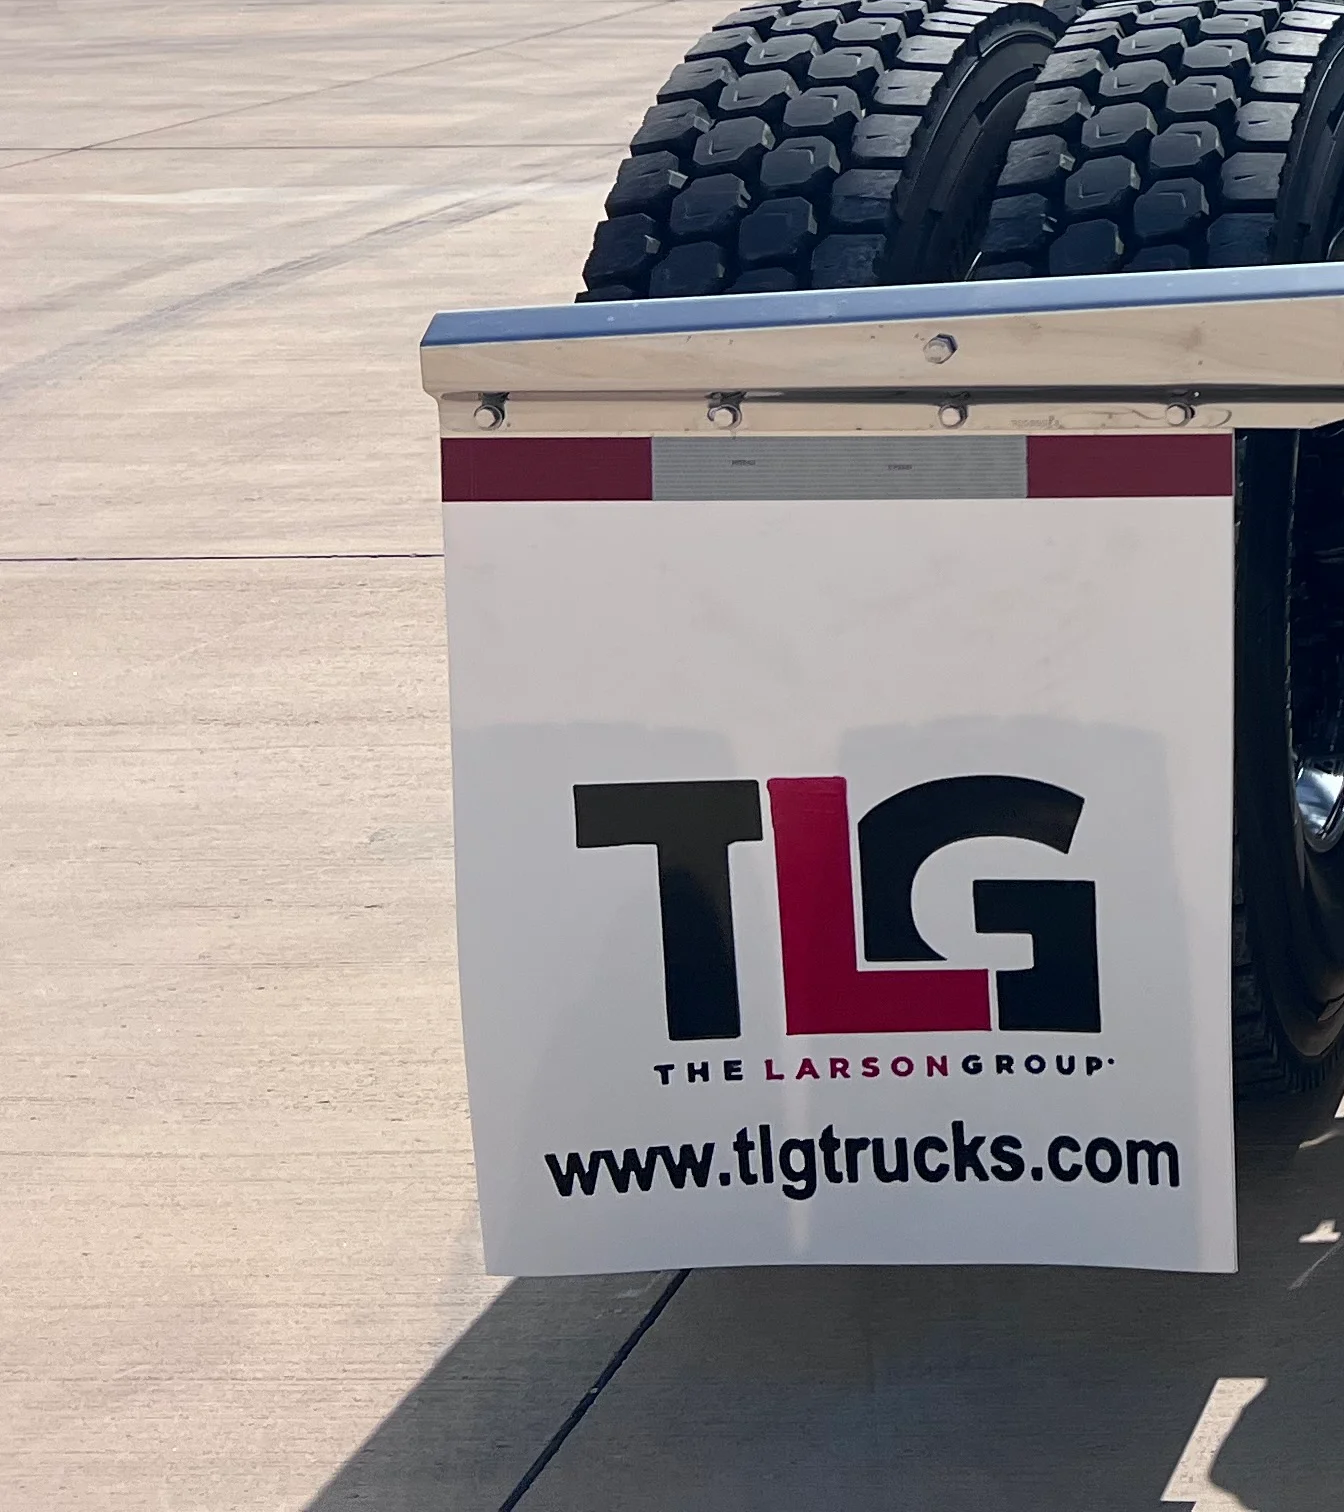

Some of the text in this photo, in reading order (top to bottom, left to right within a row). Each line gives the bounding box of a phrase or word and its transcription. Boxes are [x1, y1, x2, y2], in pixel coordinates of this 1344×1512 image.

[572, 774, 1103, 1042] TLG
[653, 1059, 745, 1086] THE
[543, 1120, 1180, 1201] www.tlgtrucks.com
